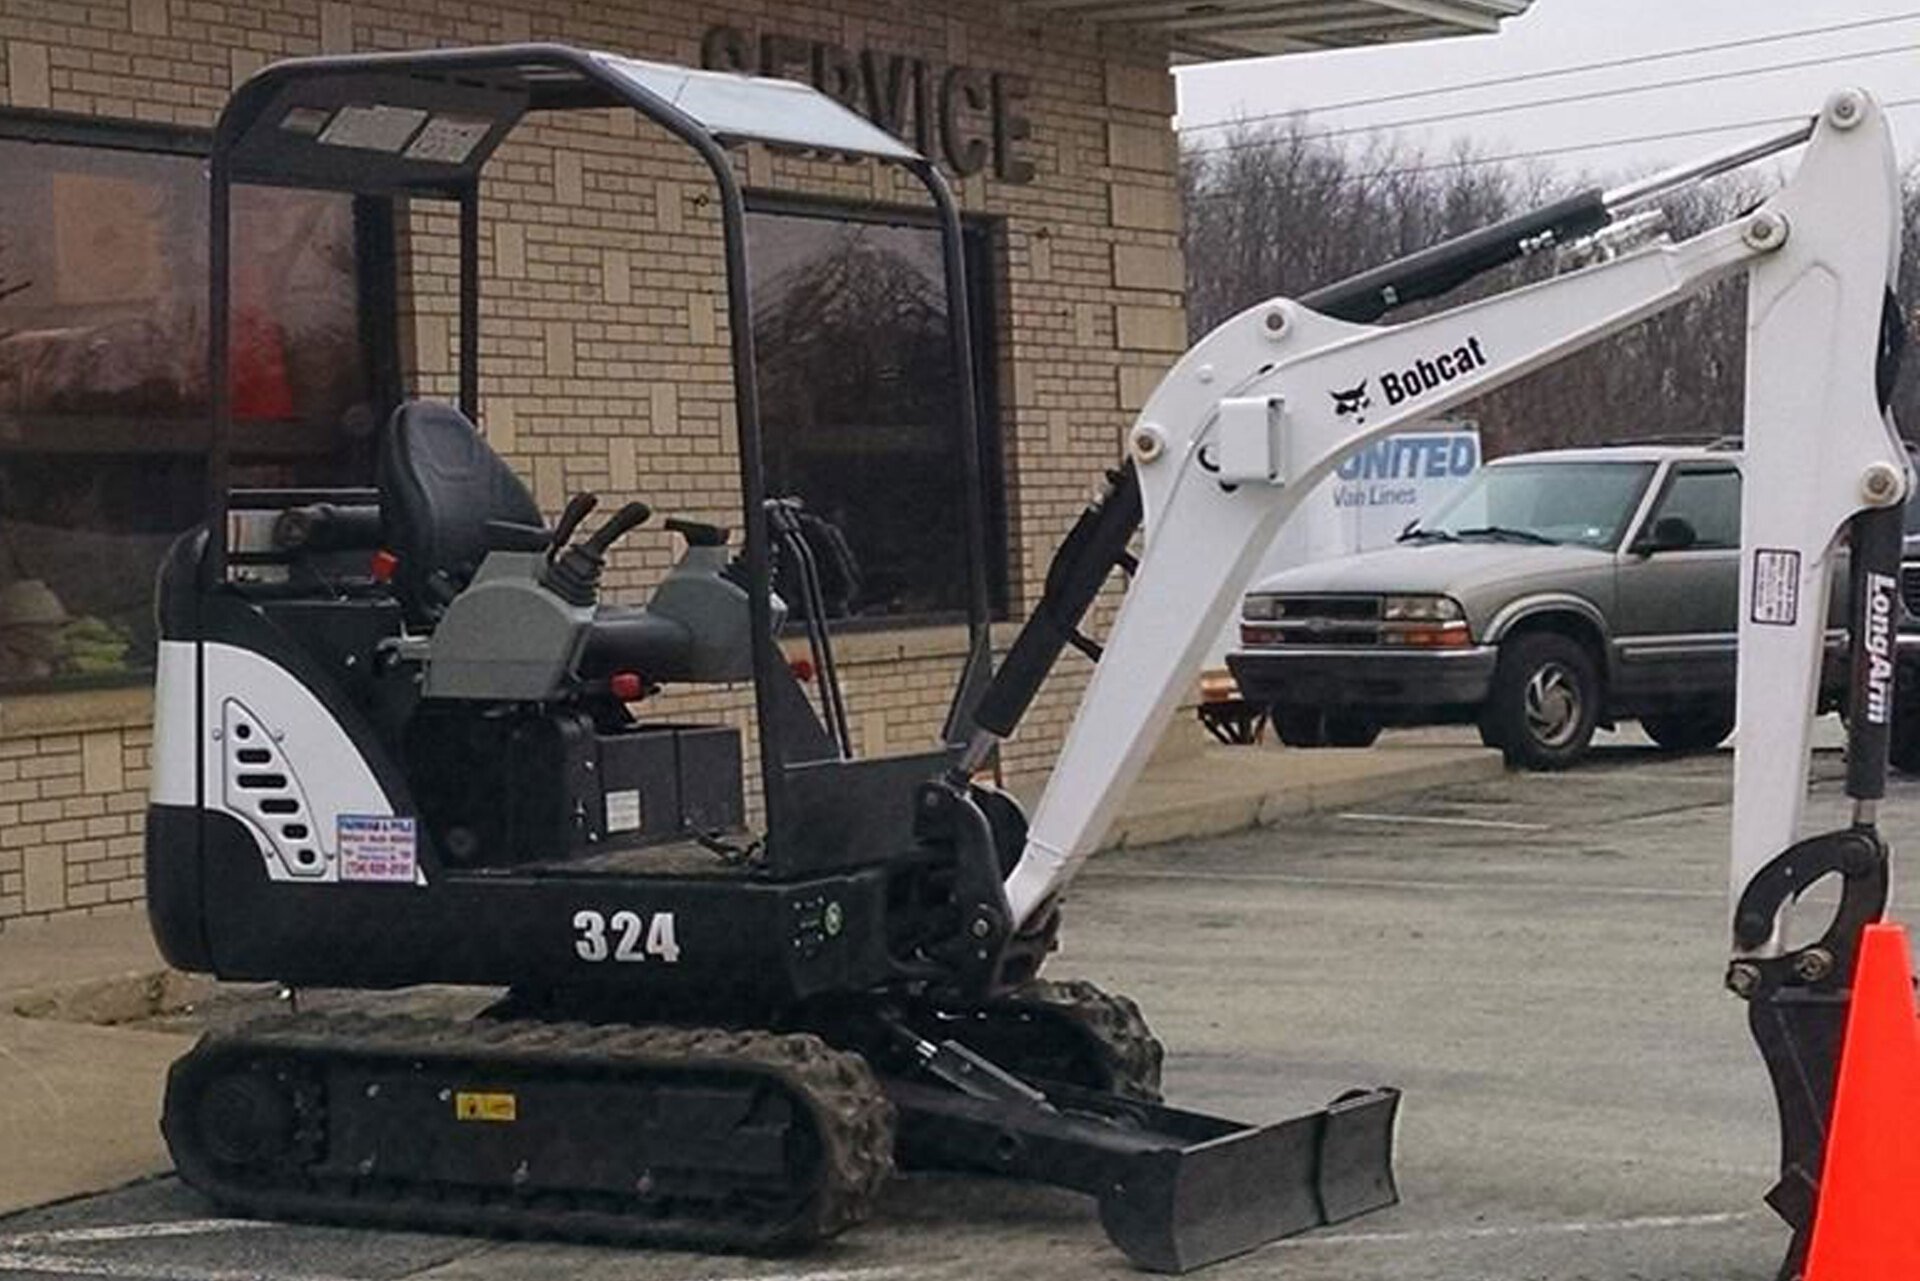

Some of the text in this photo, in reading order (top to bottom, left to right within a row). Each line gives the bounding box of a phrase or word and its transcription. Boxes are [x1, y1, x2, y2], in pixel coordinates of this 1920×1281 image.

[1379, 336, 1487, 406] Bobcat
[1337, 437, 1475, 481] UNITED
[1334, 485, 1416, 507] Van Lines
[1865, 572, 1896, 724] LongArm
[573, 910, 680, 961] 324
